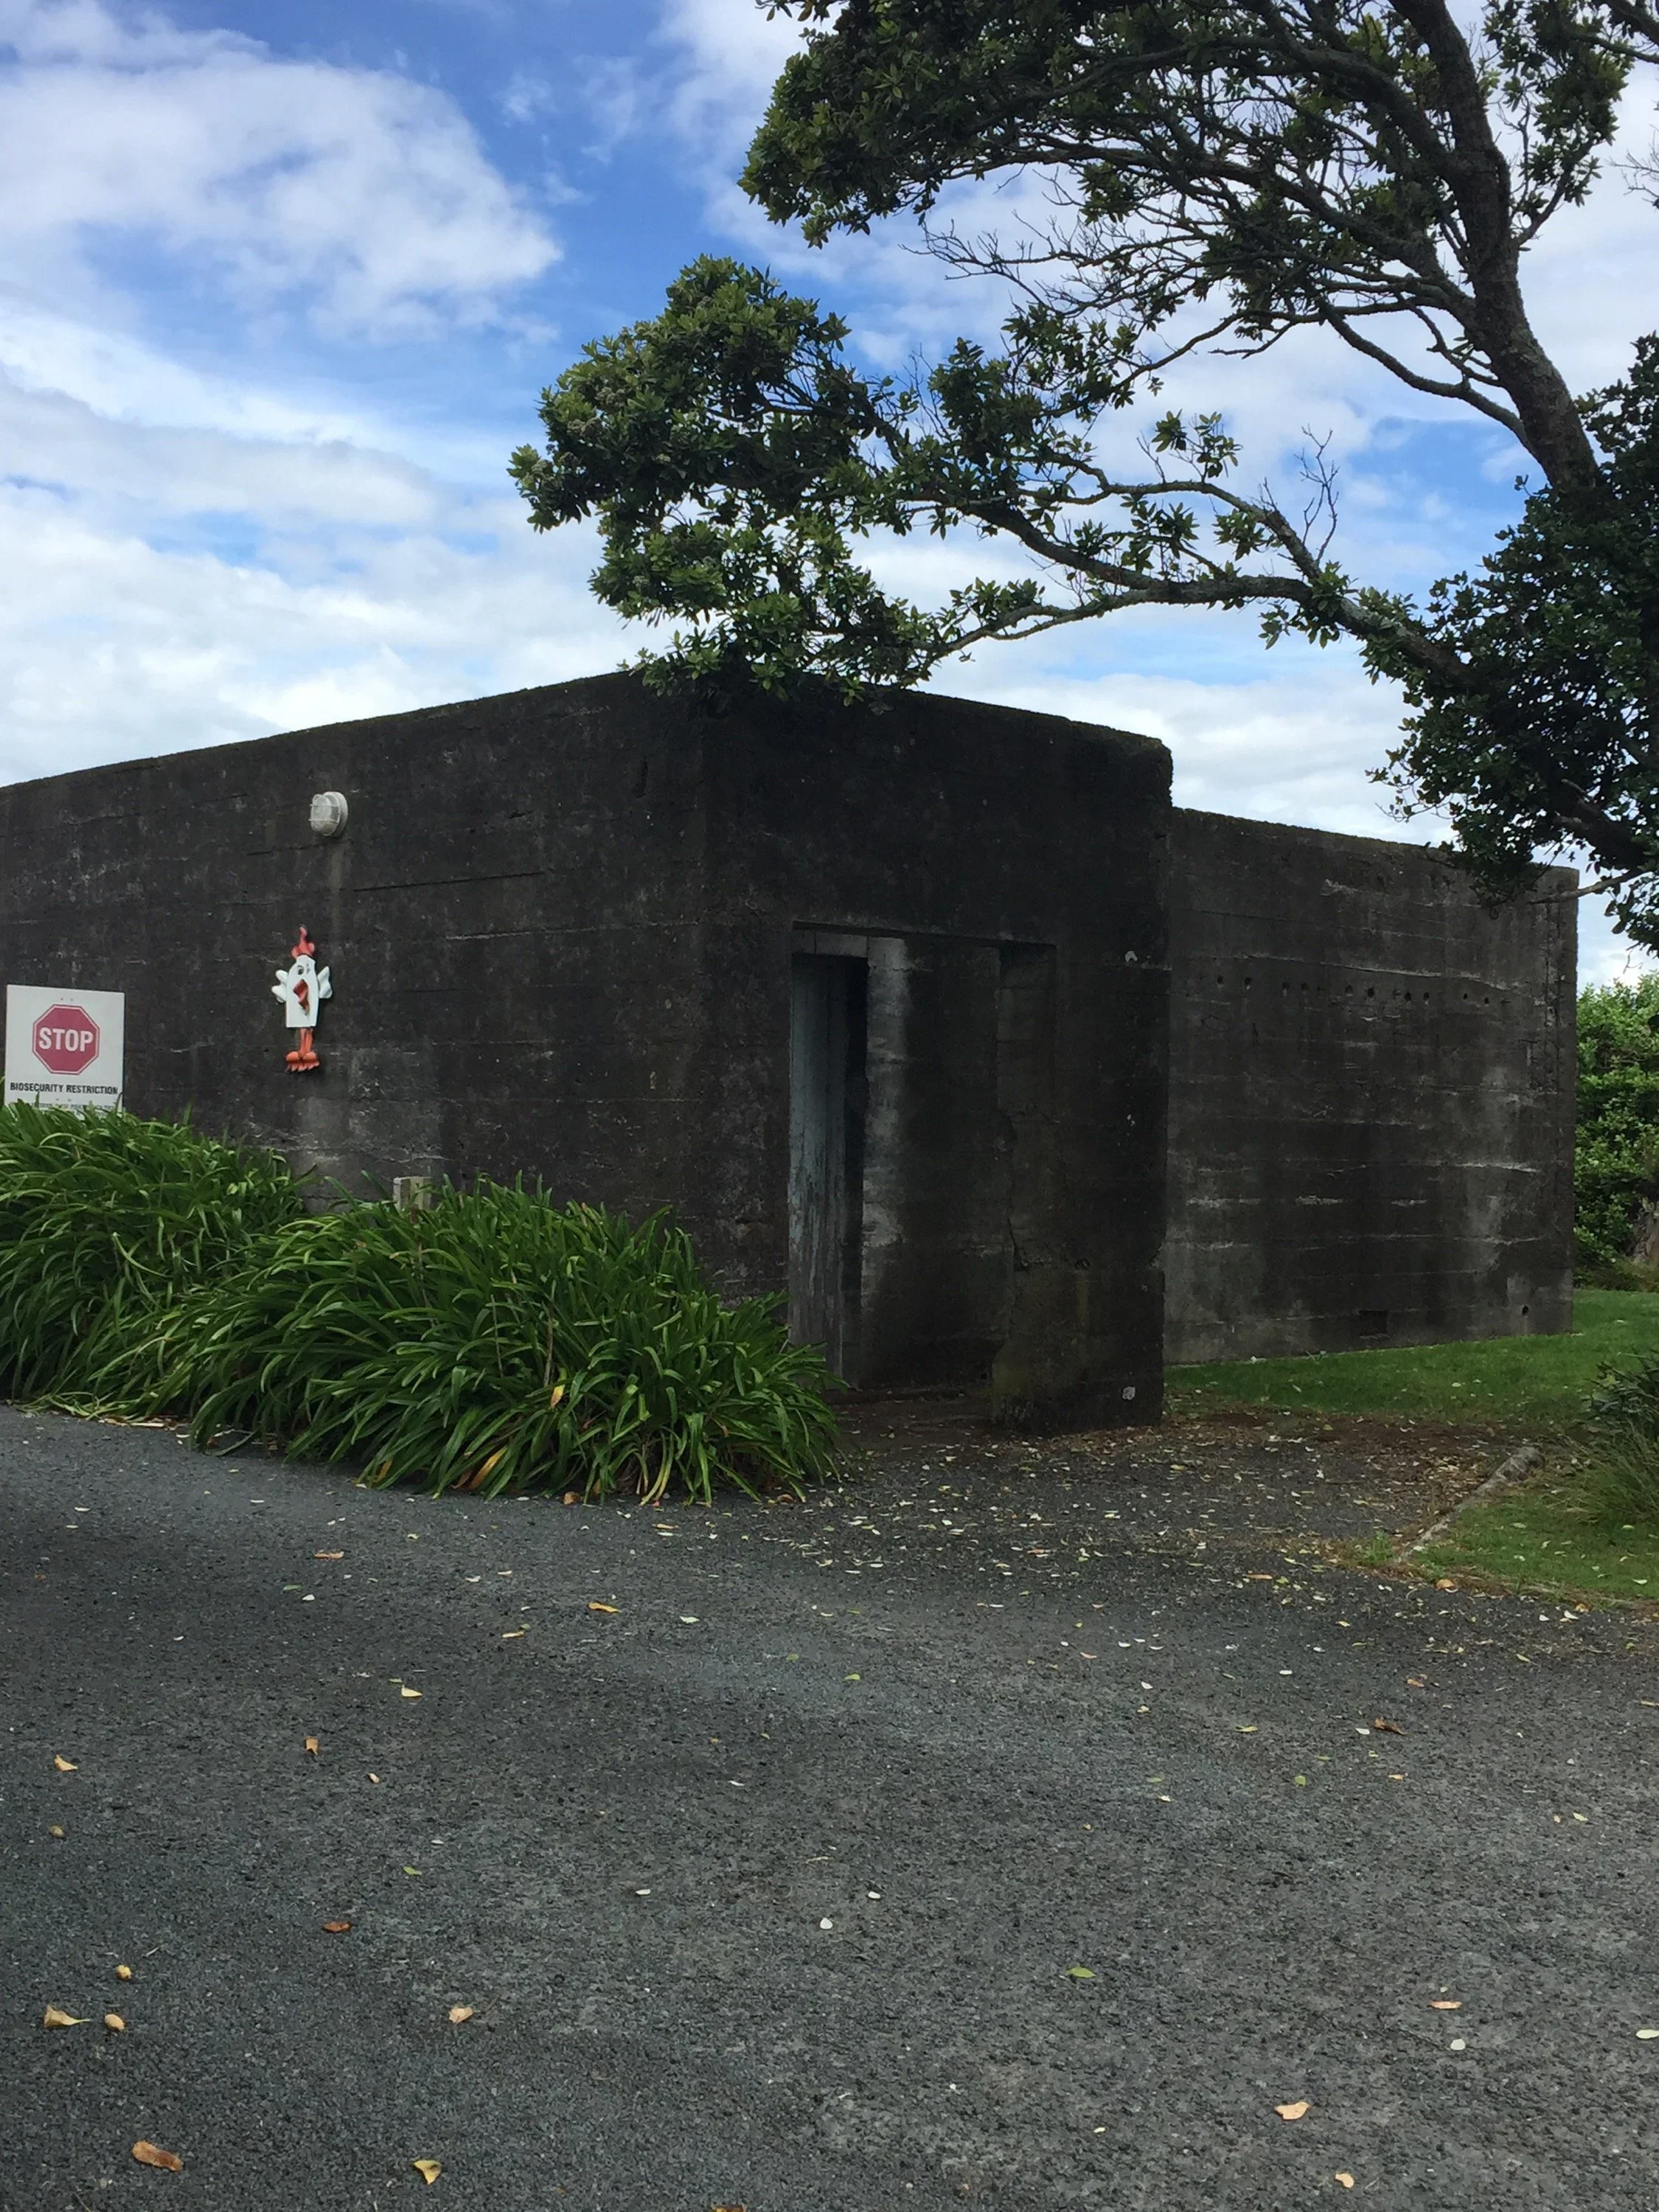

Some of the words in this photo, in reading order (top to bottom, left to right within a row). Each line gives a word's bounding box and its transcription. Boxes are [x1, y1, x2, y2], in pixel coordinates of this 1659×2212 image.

[38, 1027, 94, 1051] STOP
[10, 1082, 63, 1093] BIOSECURITY
[66, 1085, 118, 1094] RESTRICTION
